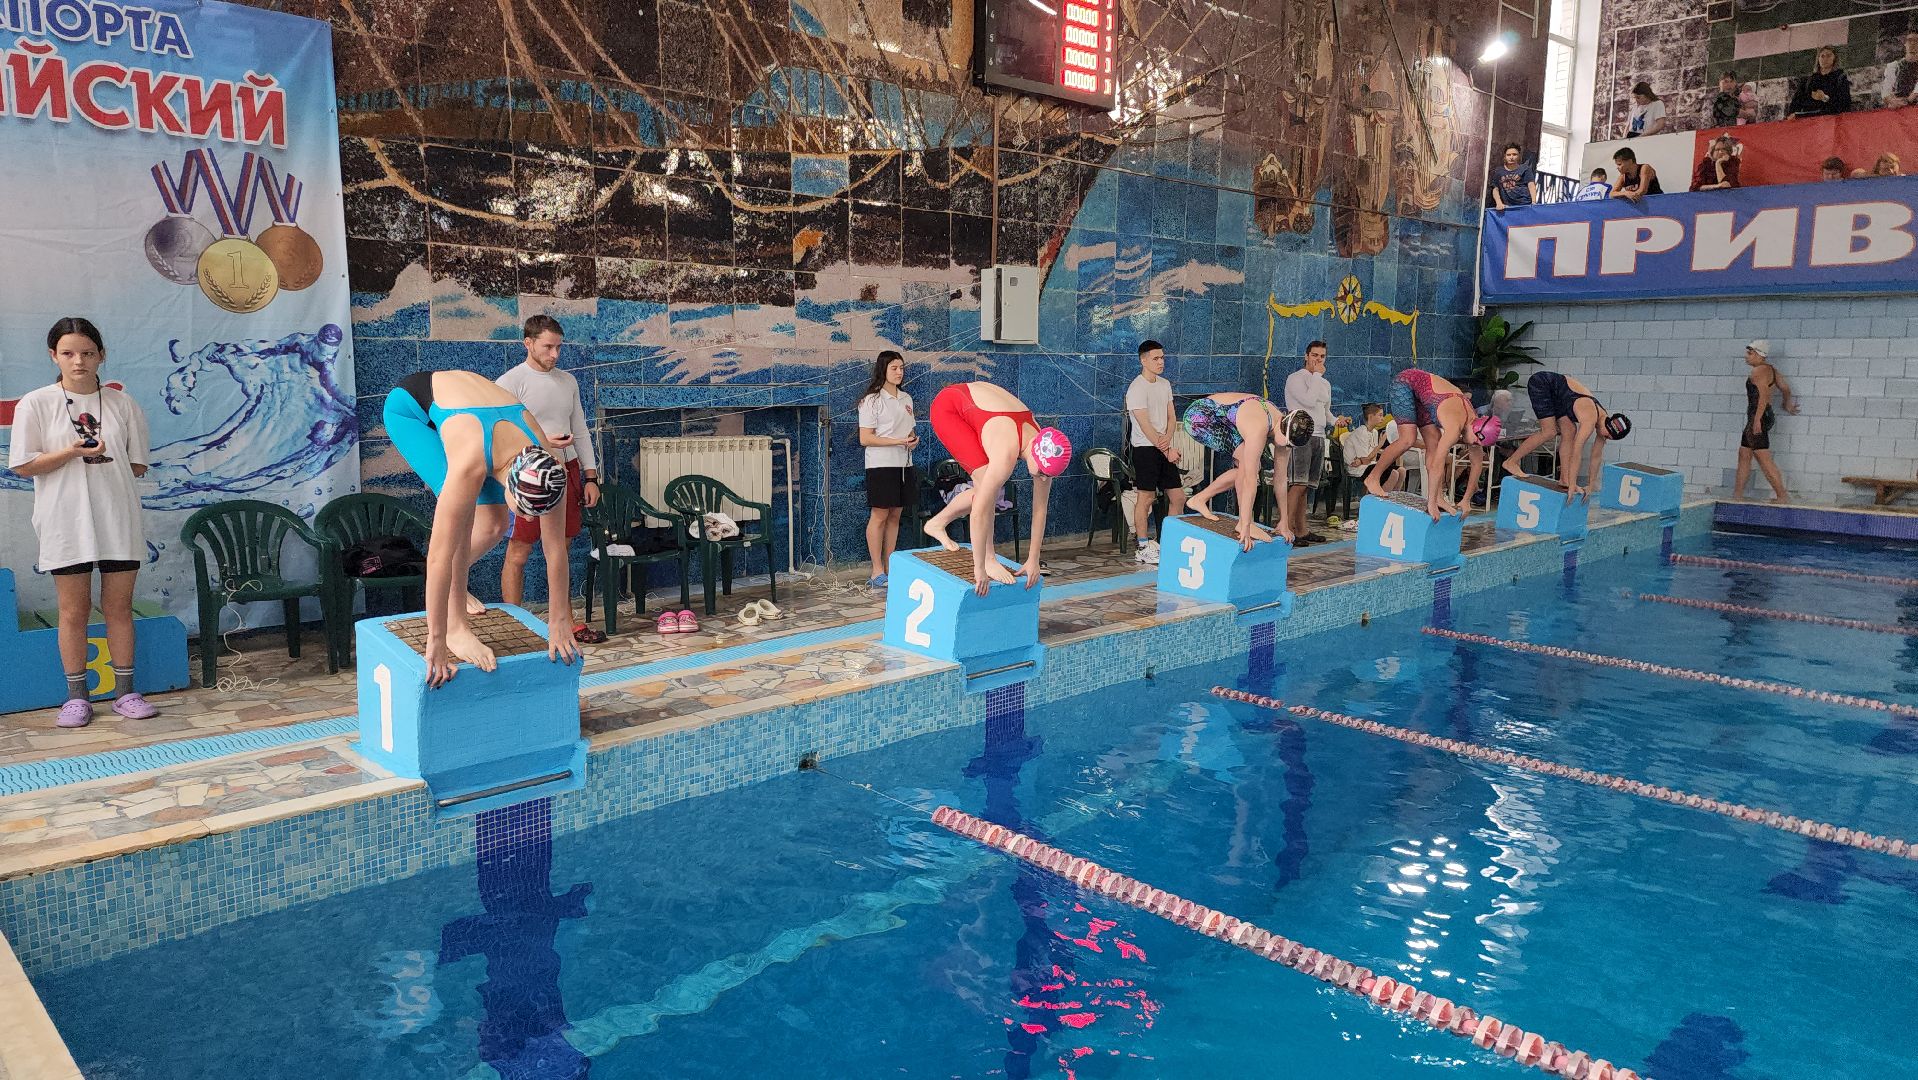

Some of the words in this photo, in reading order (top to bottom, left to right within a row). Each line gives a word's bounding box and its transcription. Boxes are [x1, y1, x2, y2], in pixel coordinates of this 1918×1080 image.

[0, 0, 193, 58] ПОРТА
[0, 39, 288, 148] ЙСКИЙ
[1504, 200, 1918, 279] ПРИВ
[226, 250, 250, 289] 1
[1516, 489, 1541, 529] 5
[1618, 474, 1643, 507] 6
[1379, 511, 1407, 555] 4
[1177, 535, 1208, 590] 3
[904, 578, 936, 648] 2
[373, 663, 395, 753] 1
